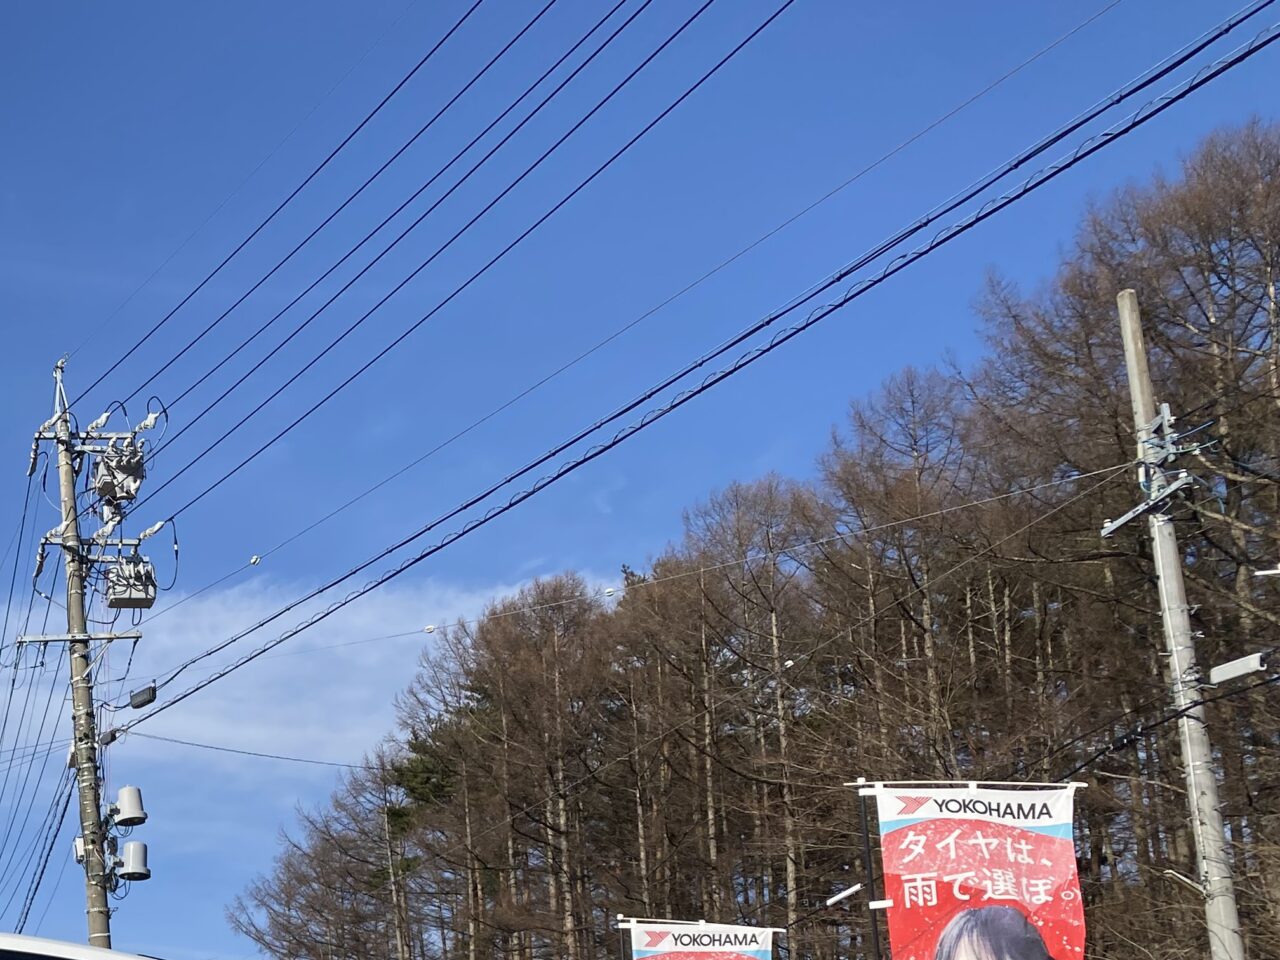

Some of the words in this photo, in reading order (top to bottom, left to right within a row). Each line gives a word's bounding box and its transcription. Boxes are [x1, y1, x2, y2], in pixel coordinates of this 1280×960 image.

[933, 798, 1053, 820] YOKOHAMA
[899, 828, 1053, 866] タイヤは、
[900, 868, 1074, 908] 雨で選ぼ。
[672, 933, 759, 947] YOKOHAMA
